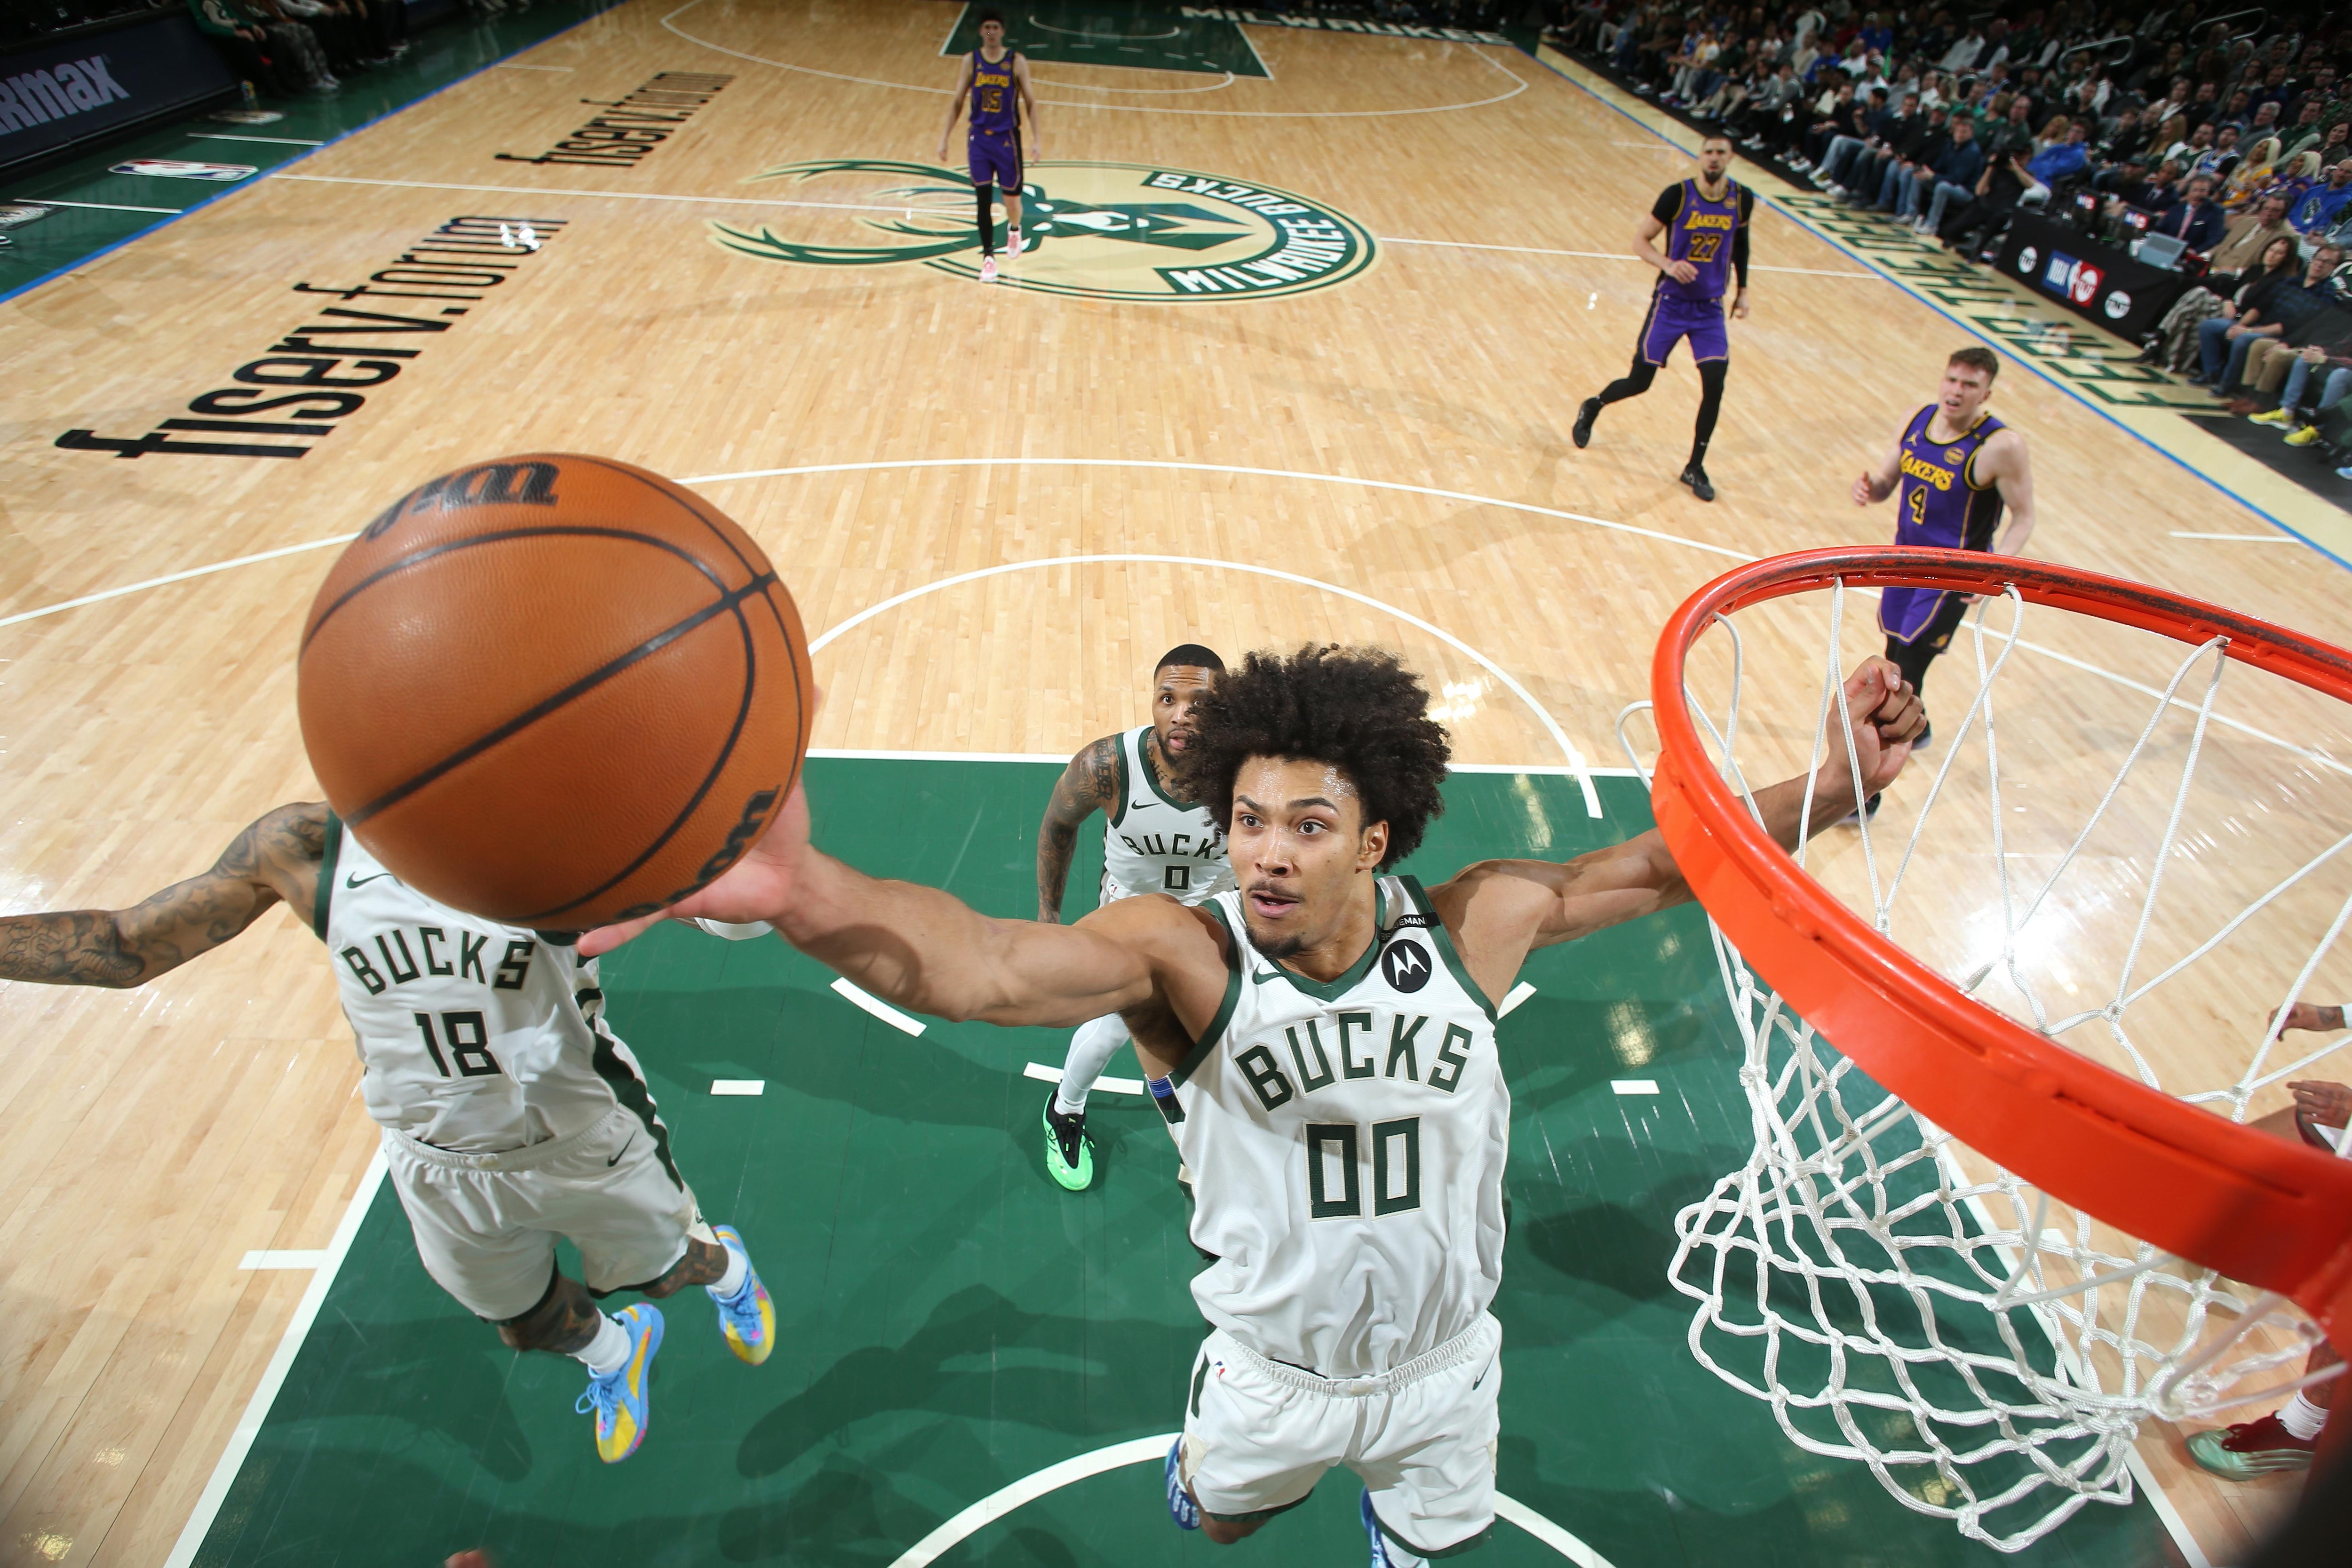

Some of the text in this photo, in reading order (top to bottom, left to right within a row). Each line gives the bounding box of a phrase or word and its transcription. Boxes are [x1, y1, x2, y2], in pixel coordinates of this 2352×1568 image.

[1181, 6, 1514, 46] MILWAUKEE
[0, 56, 131, 135] Rmax
[974, 71, 1010, 88] LAKERS
[982, 88, 1003, 113] 15
[1152, 173, 1347, 294] MILWAUKEE BUCKS
[1683, 210, 1733, 231] LAKERS
[1687, 232, 1724, 263] 27
[1908, 484, 1929, 525] 4
[1120, 833, 1229, 860] BUCK
[1163, 865, 1192, 891] 0
[341, 926, 537, 996] BUCKS
[414, 1010, 503, 1079] 18
[1232, 1011, 1474, 1112] BUCKS
[1302, 1114, 1424, 1222] 00
